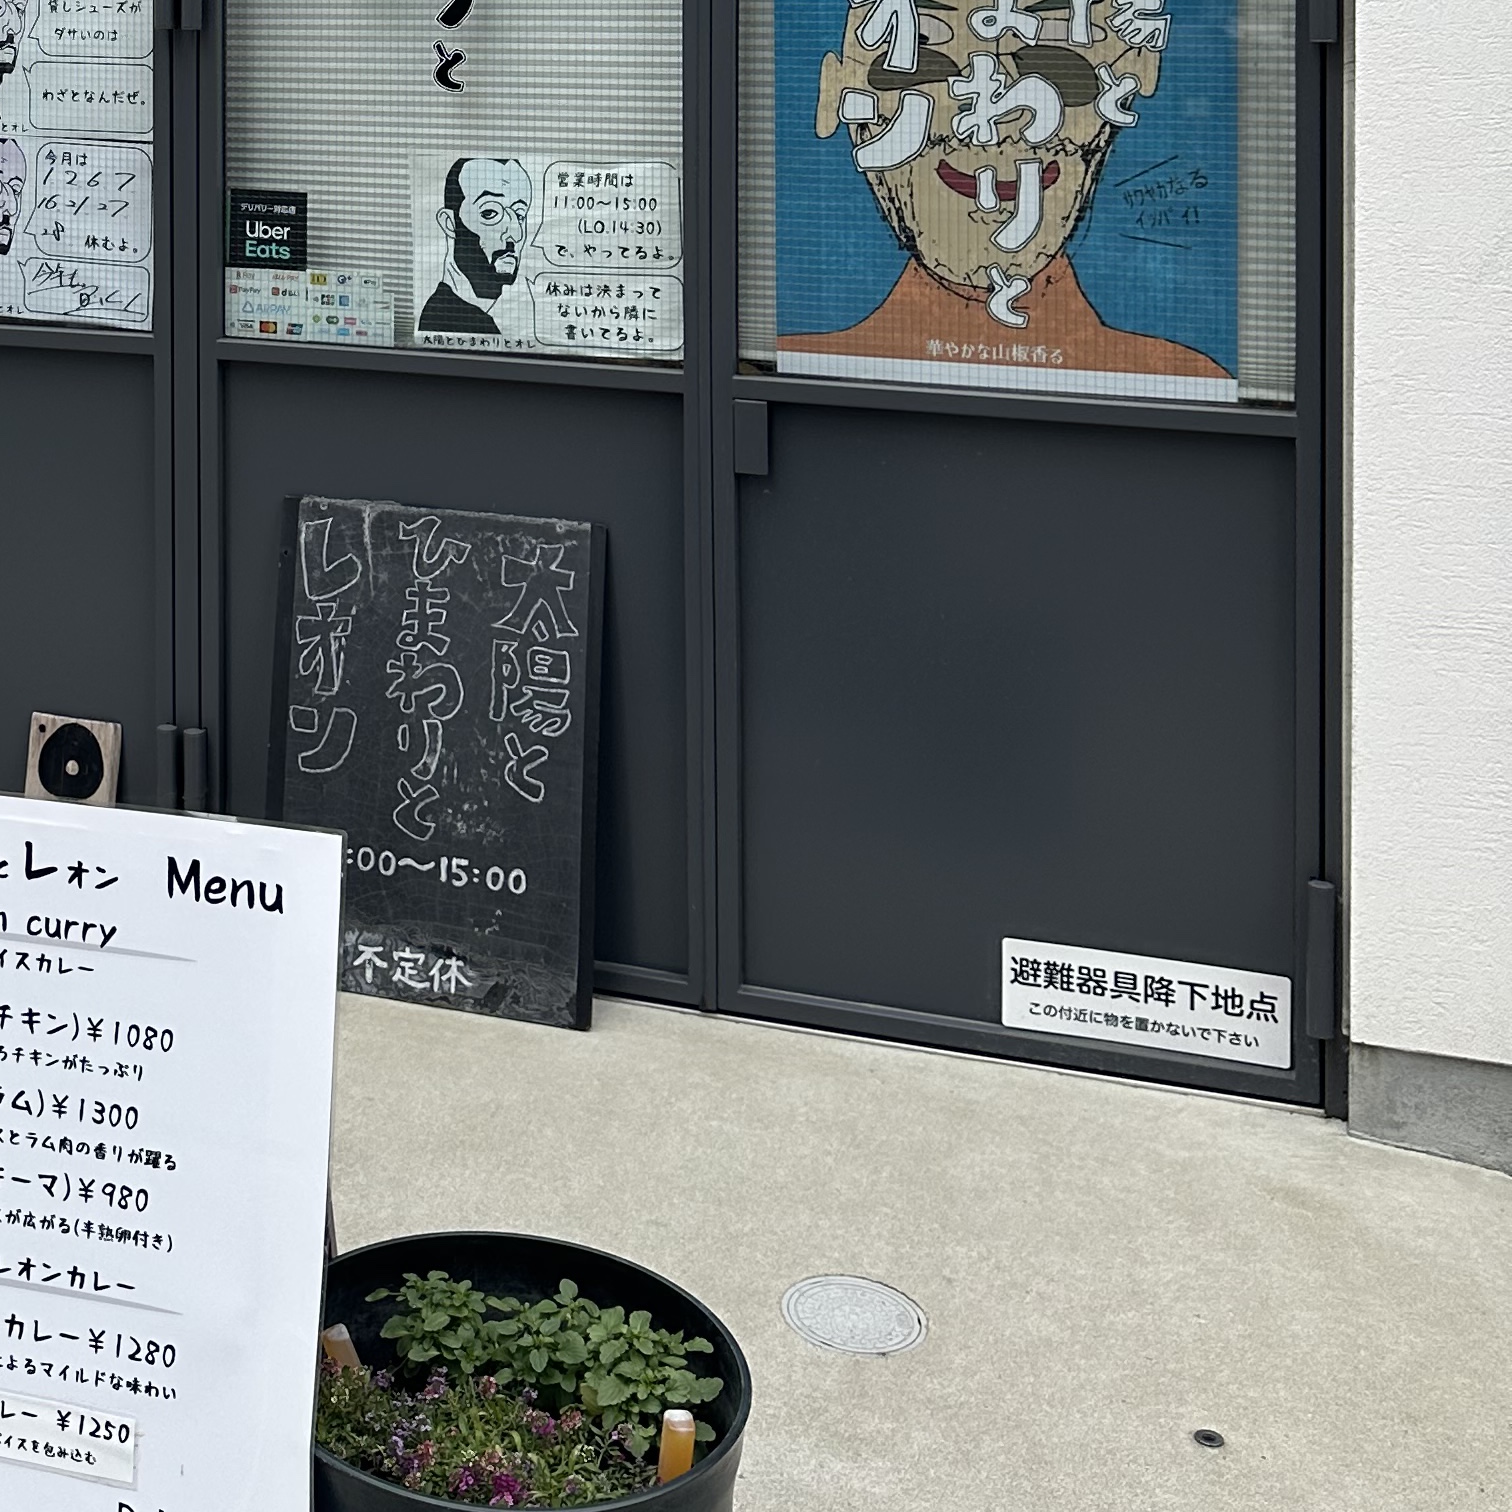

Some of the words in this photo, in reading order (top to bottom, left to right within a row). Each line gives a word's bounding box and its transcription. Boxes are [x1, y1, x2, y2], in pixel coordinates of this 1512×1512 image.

[42, 89, 146, 106] わざとなんだぜ。
[44, 149, 88, 167] 今月は
[557, 172, 633, 188] 営業時間は
[245, 220, 291, 240] Uber
[84, 235, 138, 253] 休むよ。
[245, 240, 291, 259] Eats
[555, 244, 675, 260] で、やってるよ。
[546, 282, 663, 300] 休みは決まって
[557, 302, 657, 321] ないから隣に
[564, 325, 655, 343] 書いてるよ。
[926, 339, 1064, 364] 華やかな山椒香る
[289, 517, 362, 773] レオン
[386, 516, 472, 841] ひまわりと
[490, 543, 579, 803] 太陽と
[166, 855, 284, 914] Menu
[25, 910, 118, 947] curry
[352, 938, 473, 994] 不定休
[1009, 956, 1279, 1024] 避難器具降下地点
[1029, 1002, 1260, 1048] この付近に物を置かないで下さい
[56, 1409, 130, 1444] ¥1250
